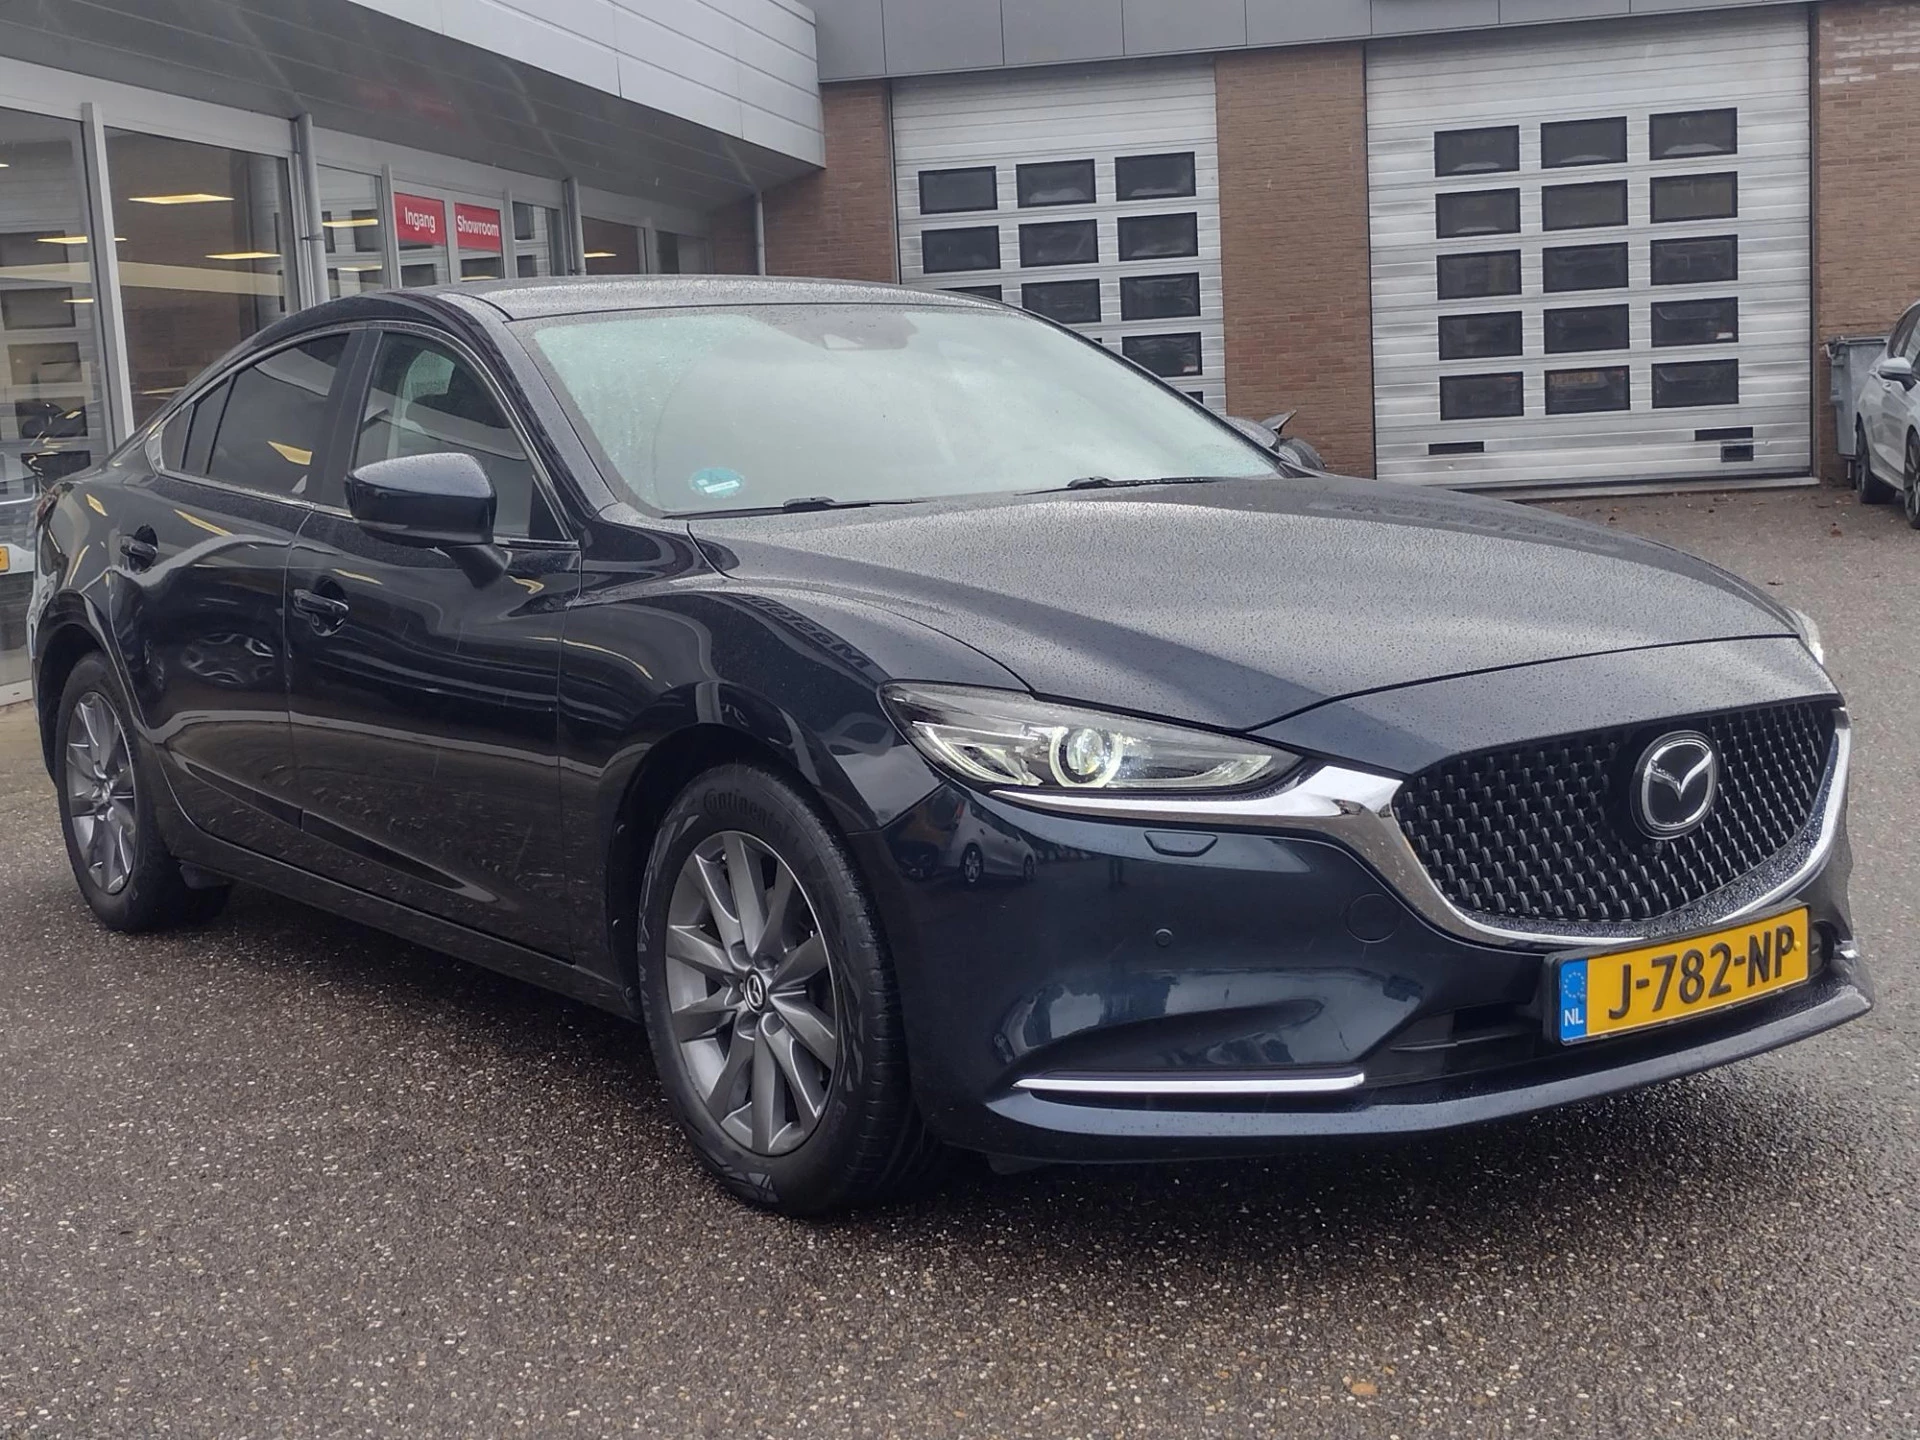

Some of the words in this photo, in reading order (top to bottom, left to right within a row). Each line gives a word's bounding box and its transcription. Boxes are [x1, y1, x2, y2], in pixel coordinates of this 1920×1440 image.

[404, 207, 435, 234] Ingang
[457, 215, 499, 237] Showroom
[1608, 924, 1796, 1020] J-782-NP
[1564, 1007, 1584, 1027] NL
